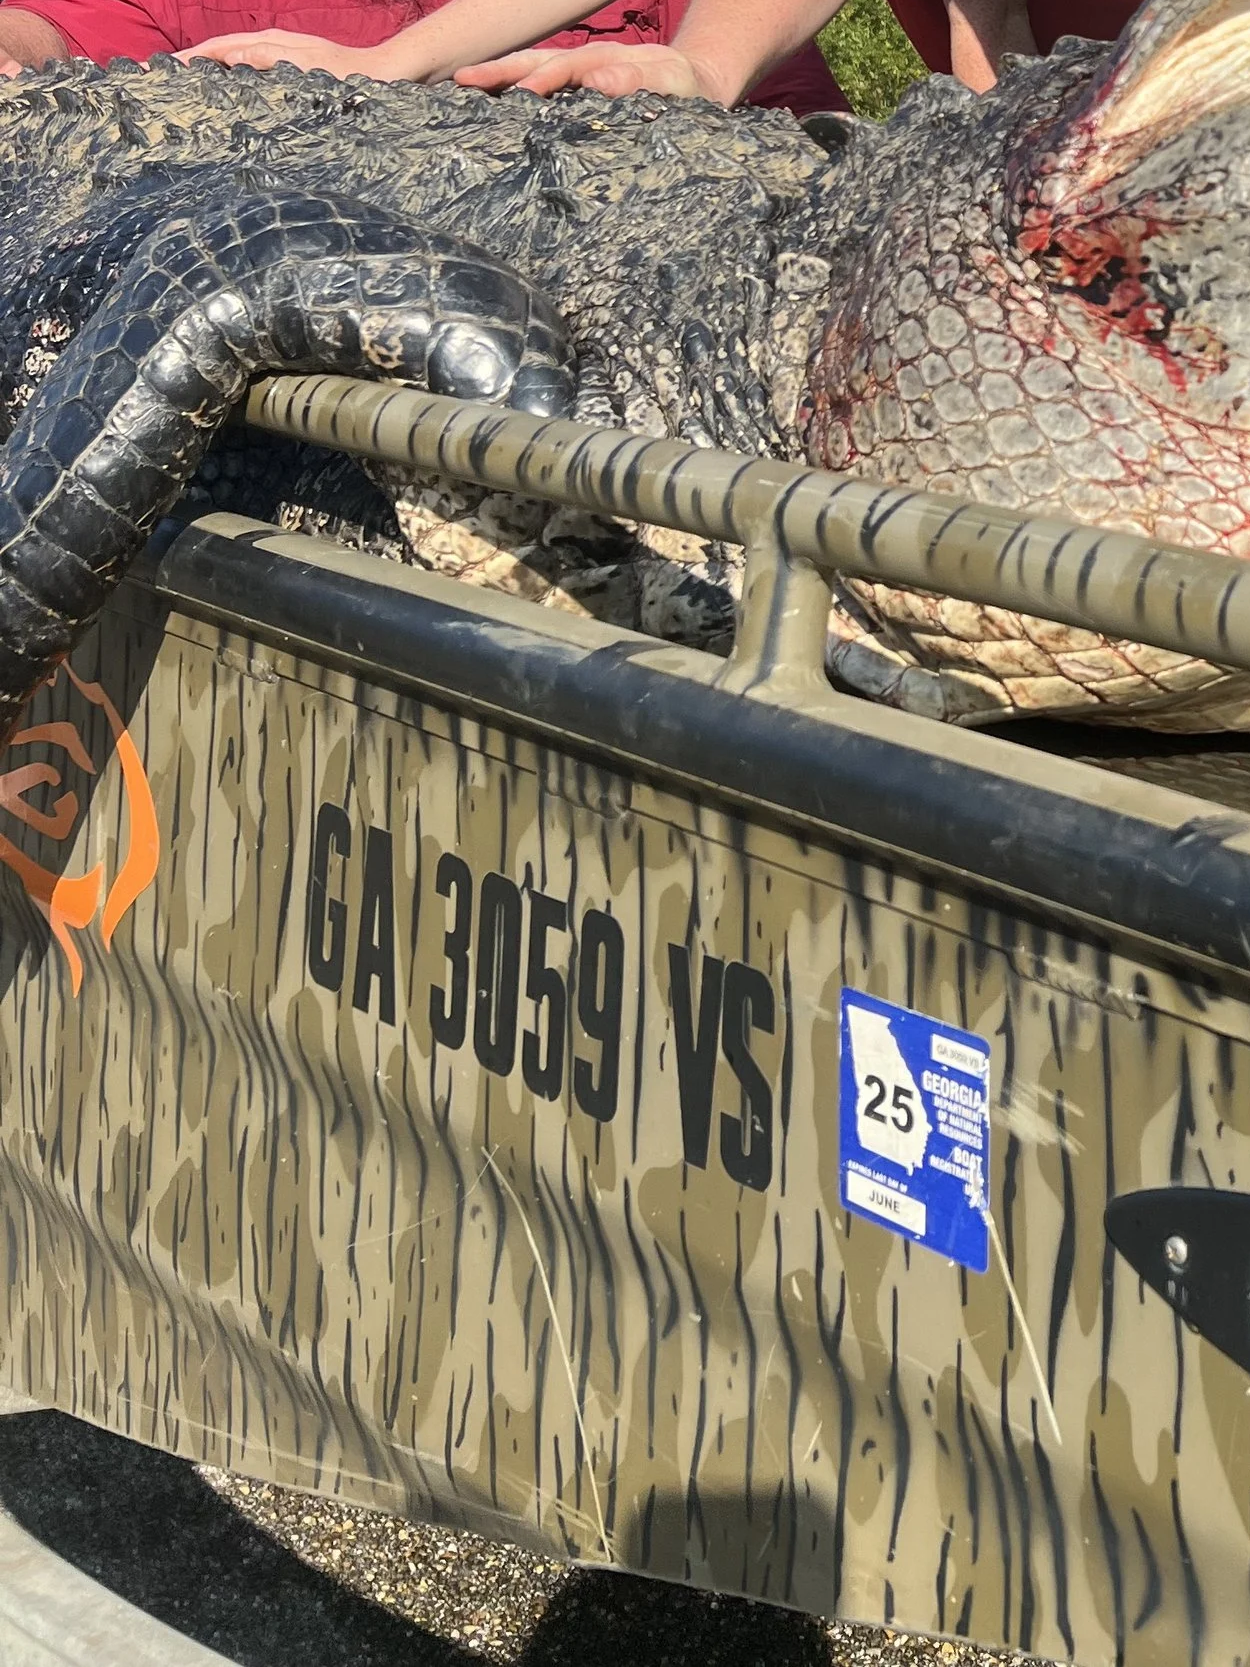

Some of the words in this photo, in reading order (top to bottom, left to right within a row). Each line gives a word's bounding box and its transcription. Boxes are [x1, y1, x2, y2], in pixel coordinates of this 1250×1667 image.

[308, 801, 396, 1027] GA
[429, 852, 625, 1124] 3059
[667, 942, 776, 1193] VS
[922, 1069, 982, 1110] GEORGIA
[864, 1075, 915, 1133] 25
[933, 1095, 982, 1124] DEPARTMENT
[939, 1122, 983, 1150] RESOURCES
[949, 1112, 982, 1138] NATURAL
[953, 1146, 983, 1170] BOAT
[868, 1190, 900, 1214] JUNE
